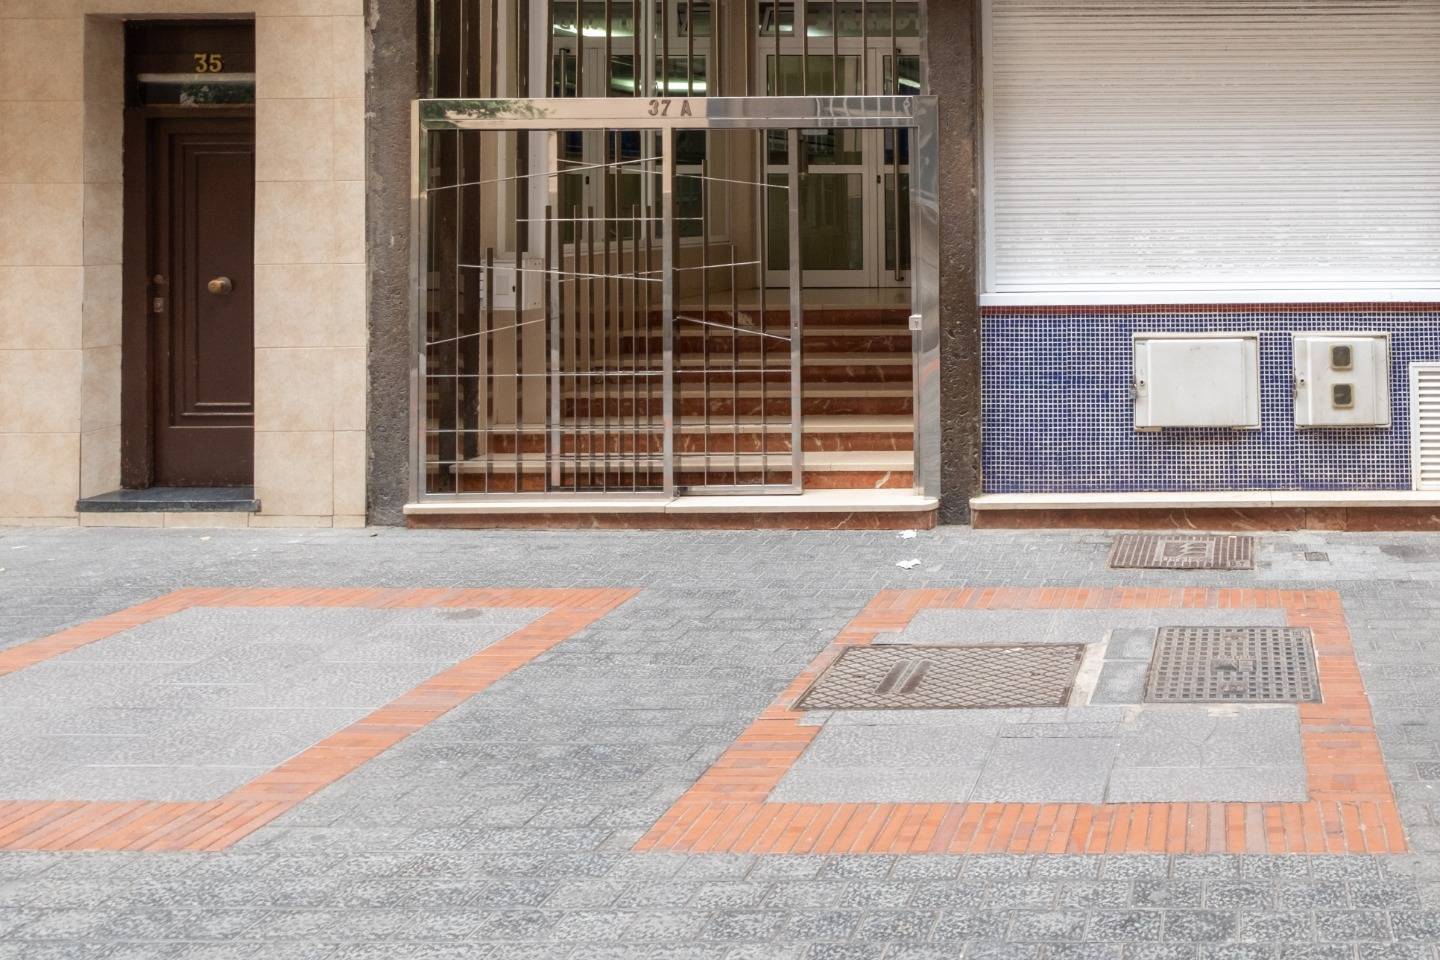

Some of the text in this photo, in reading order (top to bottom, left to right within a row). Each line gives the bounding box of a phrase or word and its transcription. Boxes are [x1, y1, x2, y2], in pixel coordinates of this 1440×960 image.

[193, 53, 223, 73] 35
[647, 99, 693, 117] 37 A
